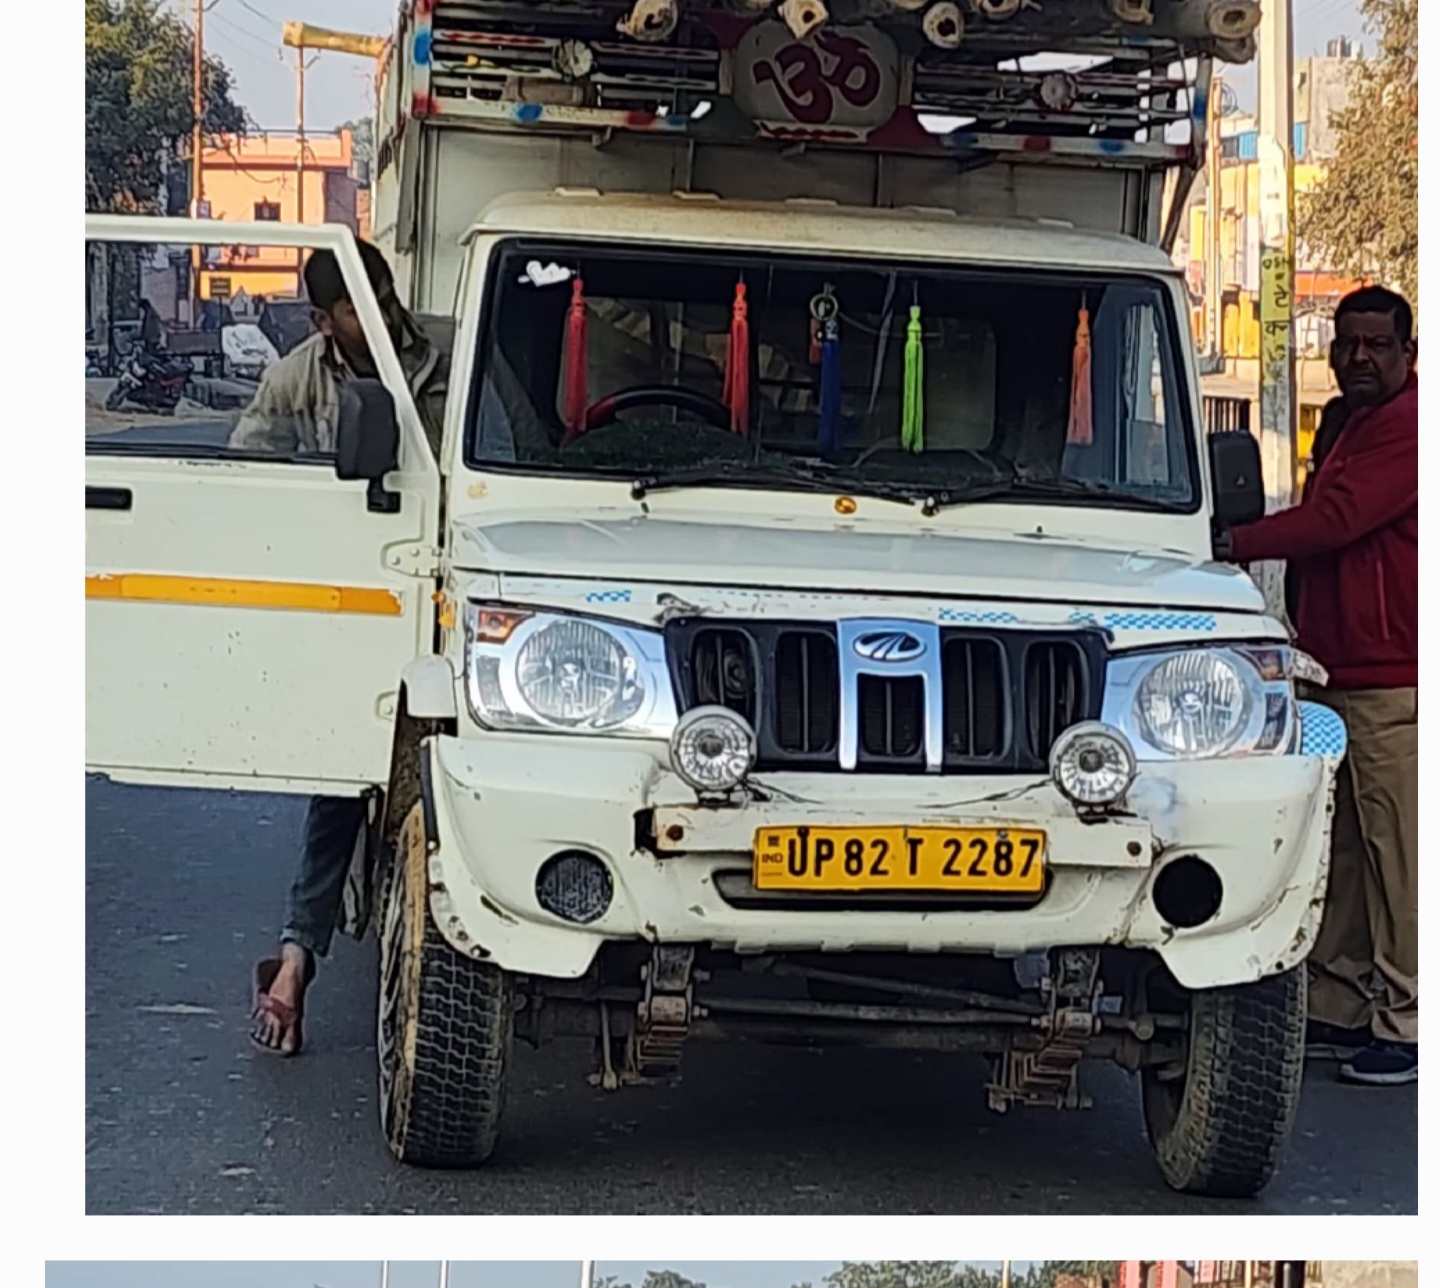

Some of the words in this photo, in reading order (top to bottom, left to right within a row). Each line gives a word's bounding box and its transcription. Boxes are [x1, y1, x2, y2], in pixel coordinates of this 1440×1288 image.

[761, 852, 783, 864] IND
[787, 837, 834, 877] UP
[844, 838, 889, 876] 82
[906, 837, 924, 876] T
[941, 837, 1040, 877] 2287
